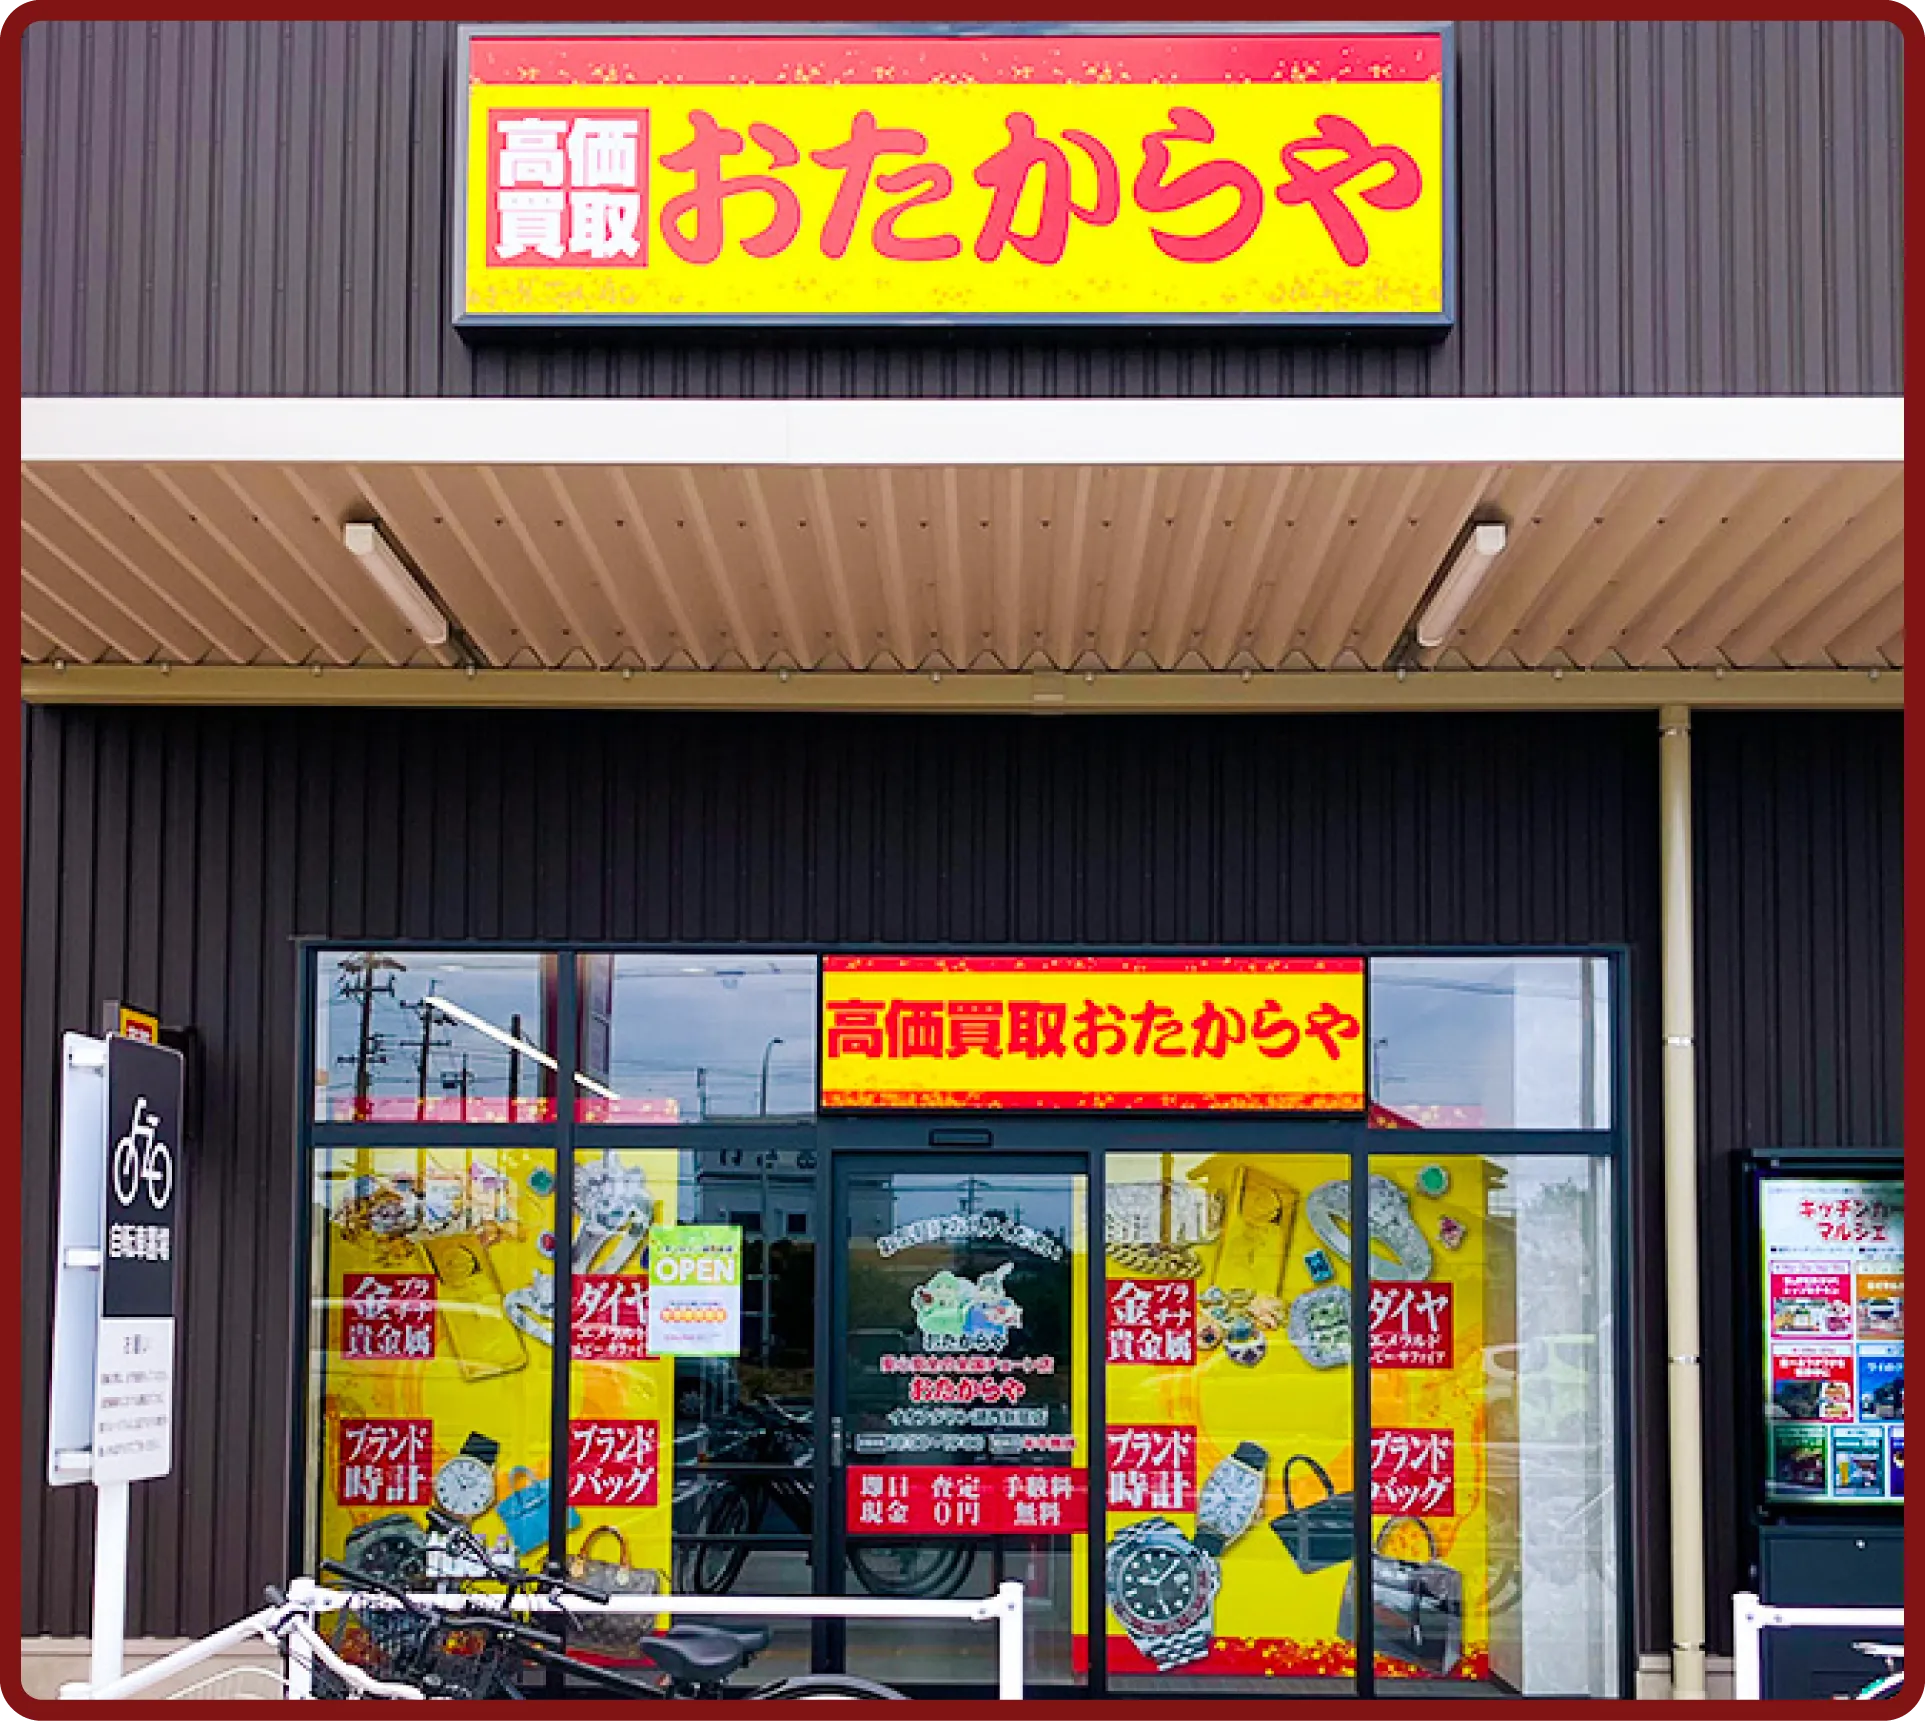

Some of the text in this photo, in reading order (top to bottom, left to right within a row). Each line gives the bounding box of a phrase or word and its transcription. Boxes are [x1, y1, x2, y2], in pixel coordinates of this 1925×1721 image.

[496, 119, 639, 186] 高価
[658, 105, 1424, 266] おたからや
[496, 190, 641, 259] 買取
[825, 999, 1361, 1061] 高価買取おたからや
[655, 1256, 736, 1282] OPEN
[351, 1276, 392, 1319] 金
[1113, 1281, 1154, 1326] 金
[1370, 1288, 1449, 1333] ダイヤ
[1107, 1328, 1192, 1362] 貴金属
[910, 1377, 1027, 1404] おたからや
[345, 1422, 428, 1463] ブランド
[572, 1423, 655, 1464] ブランド
[1107, 1429, 1192, 1470] ブランド
[1370, 1430, 1450, 1474] ブランド
[345, 1464, 428, 1503] 時計
[569, 1467, 655, 1503] バッグ
[1108, 1470, 1190, 1509] 時計
